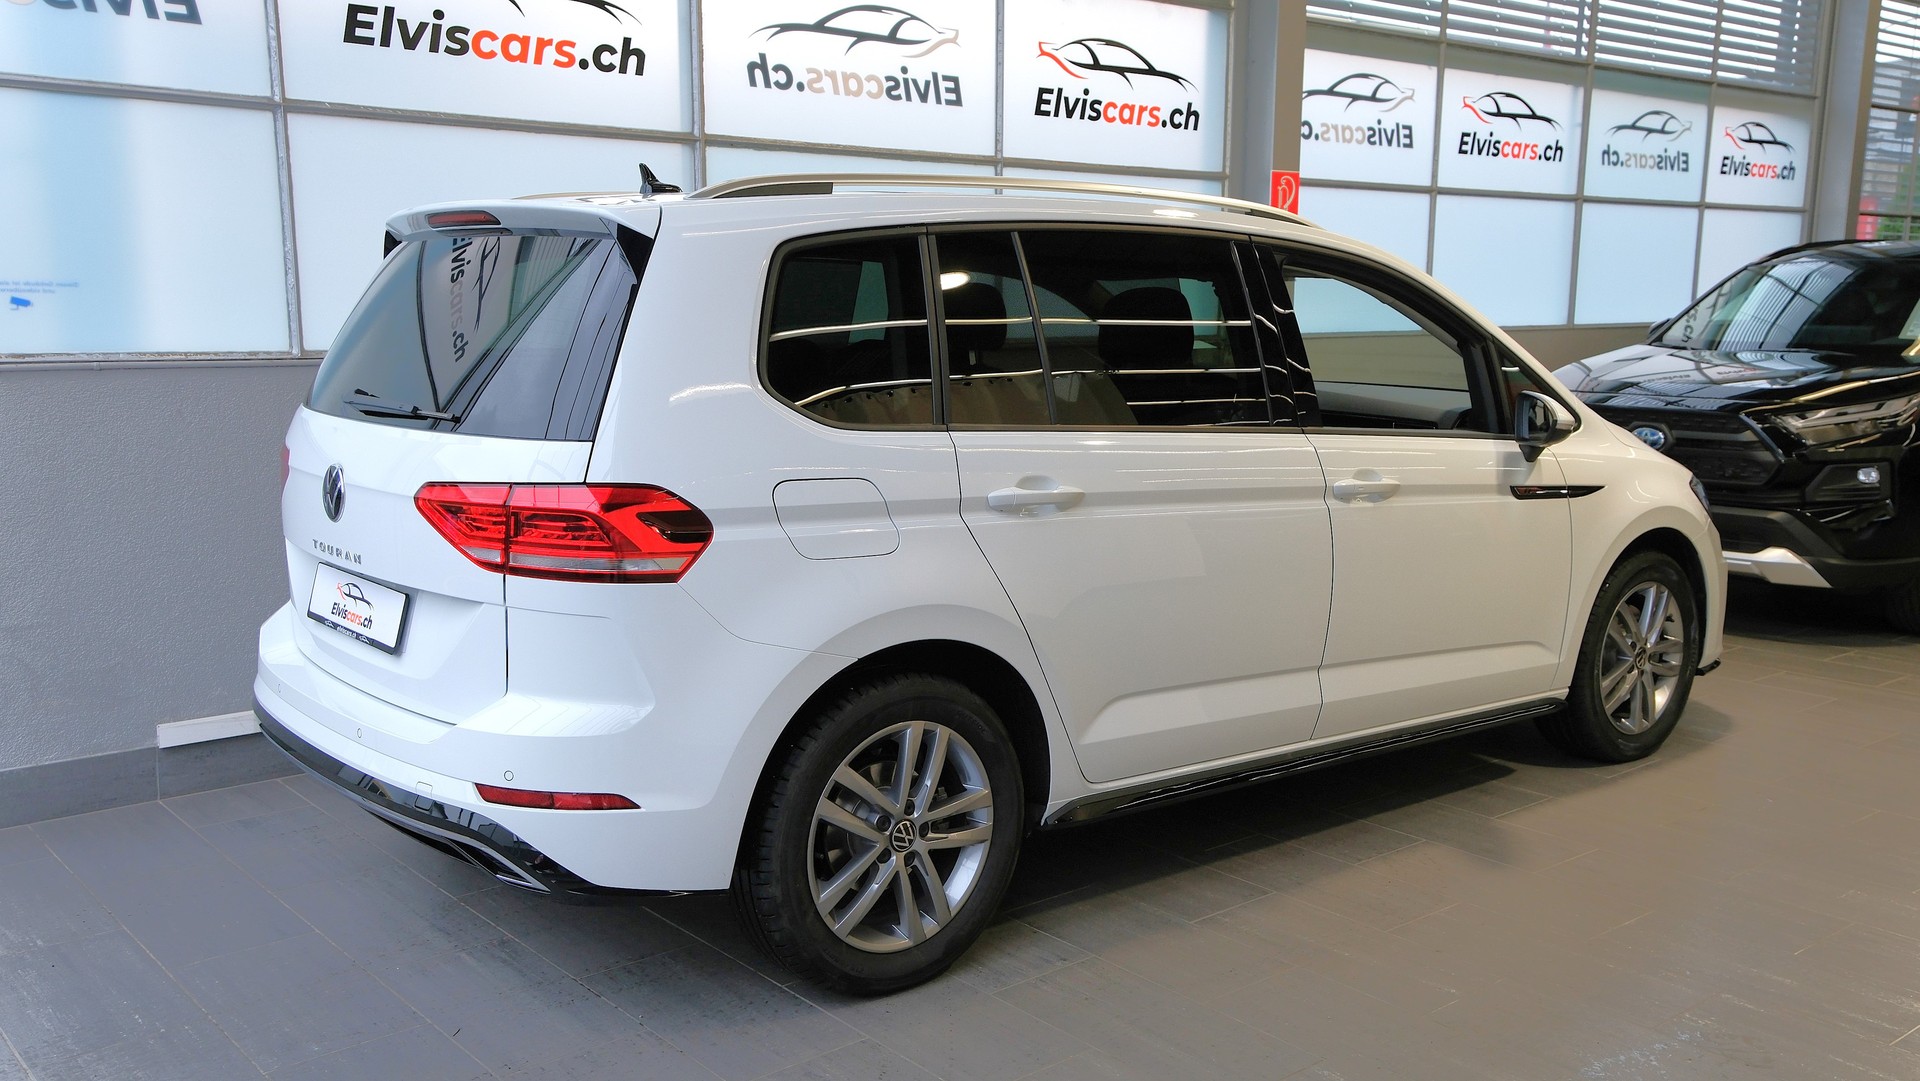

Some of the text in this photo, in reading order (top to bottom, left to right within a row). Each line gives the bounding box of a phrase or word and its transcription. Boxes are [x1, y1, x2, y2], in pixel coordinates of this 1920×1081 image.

[343, 4, 647, 76] Elviscars.ch
[1034, 86, 1200, 132] Elviscars.ch
[1458, 131, 1564, 163] Elviscars.ch
[1720, 155, 1797, 182] Elviscars.ch
[312, 539, 362, 565] TOURAN
[331, 602, 373, 630] Elviscars.ch
